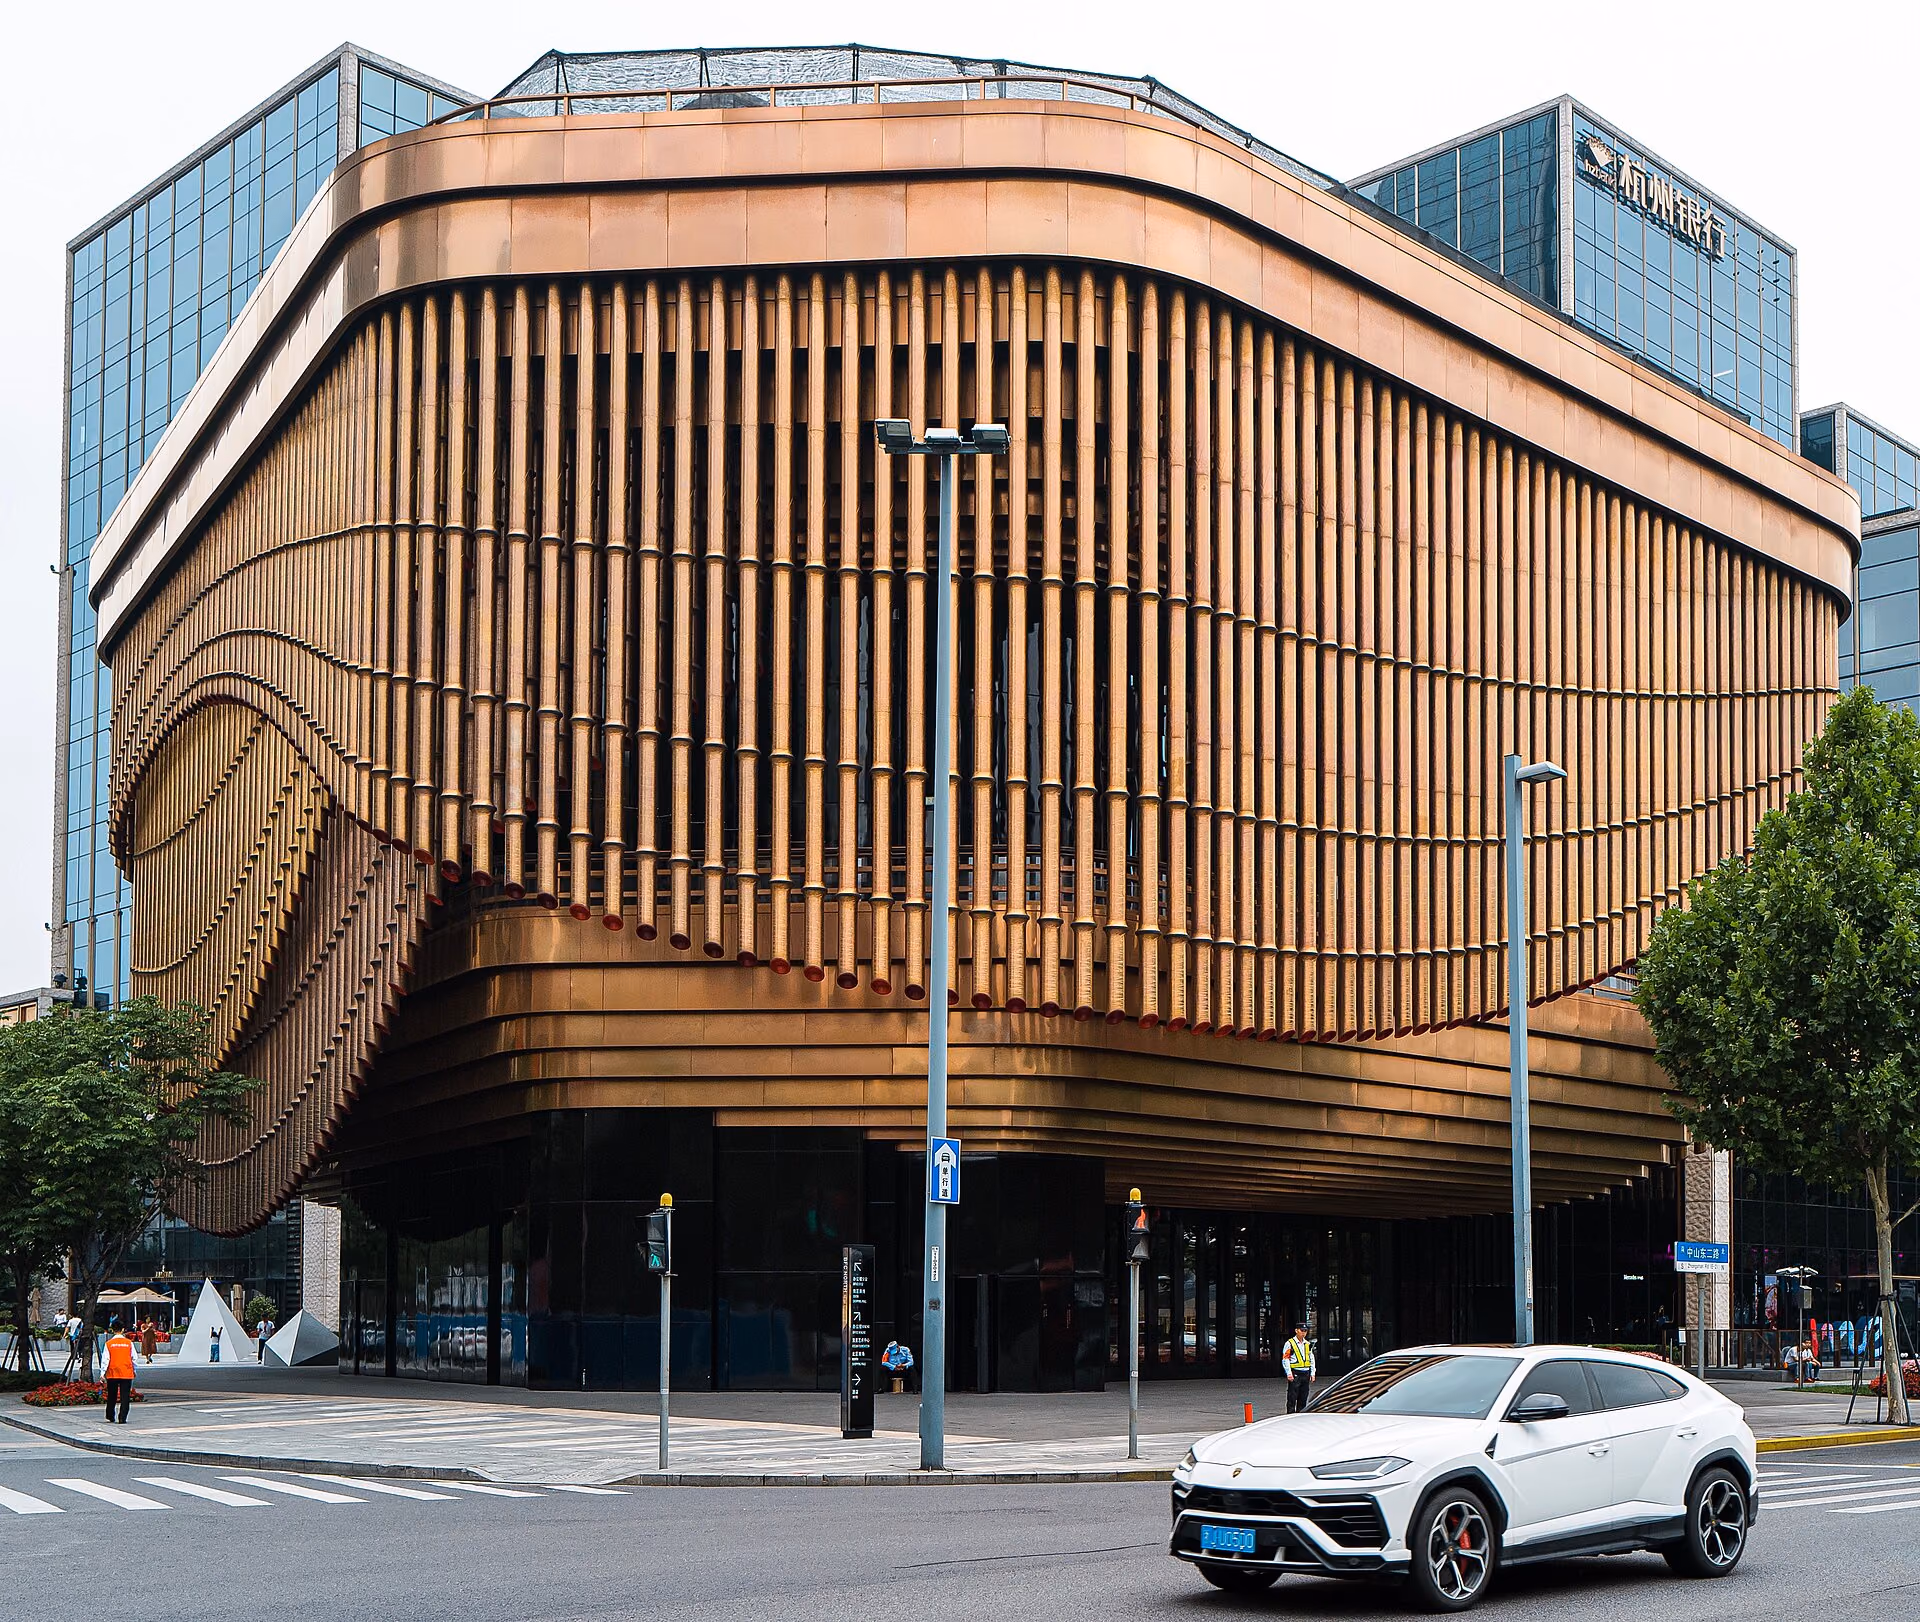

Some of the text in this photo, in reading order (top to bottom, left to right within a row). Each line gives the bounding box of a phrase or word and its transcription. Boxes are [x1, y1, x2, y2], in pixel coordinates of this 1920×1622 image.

[1619, 154, 1727, 257] 杭州银行
[941, 1166, 949, 1198] 单行道
[1687, 1247, 1719, 1259] 中山东二路
